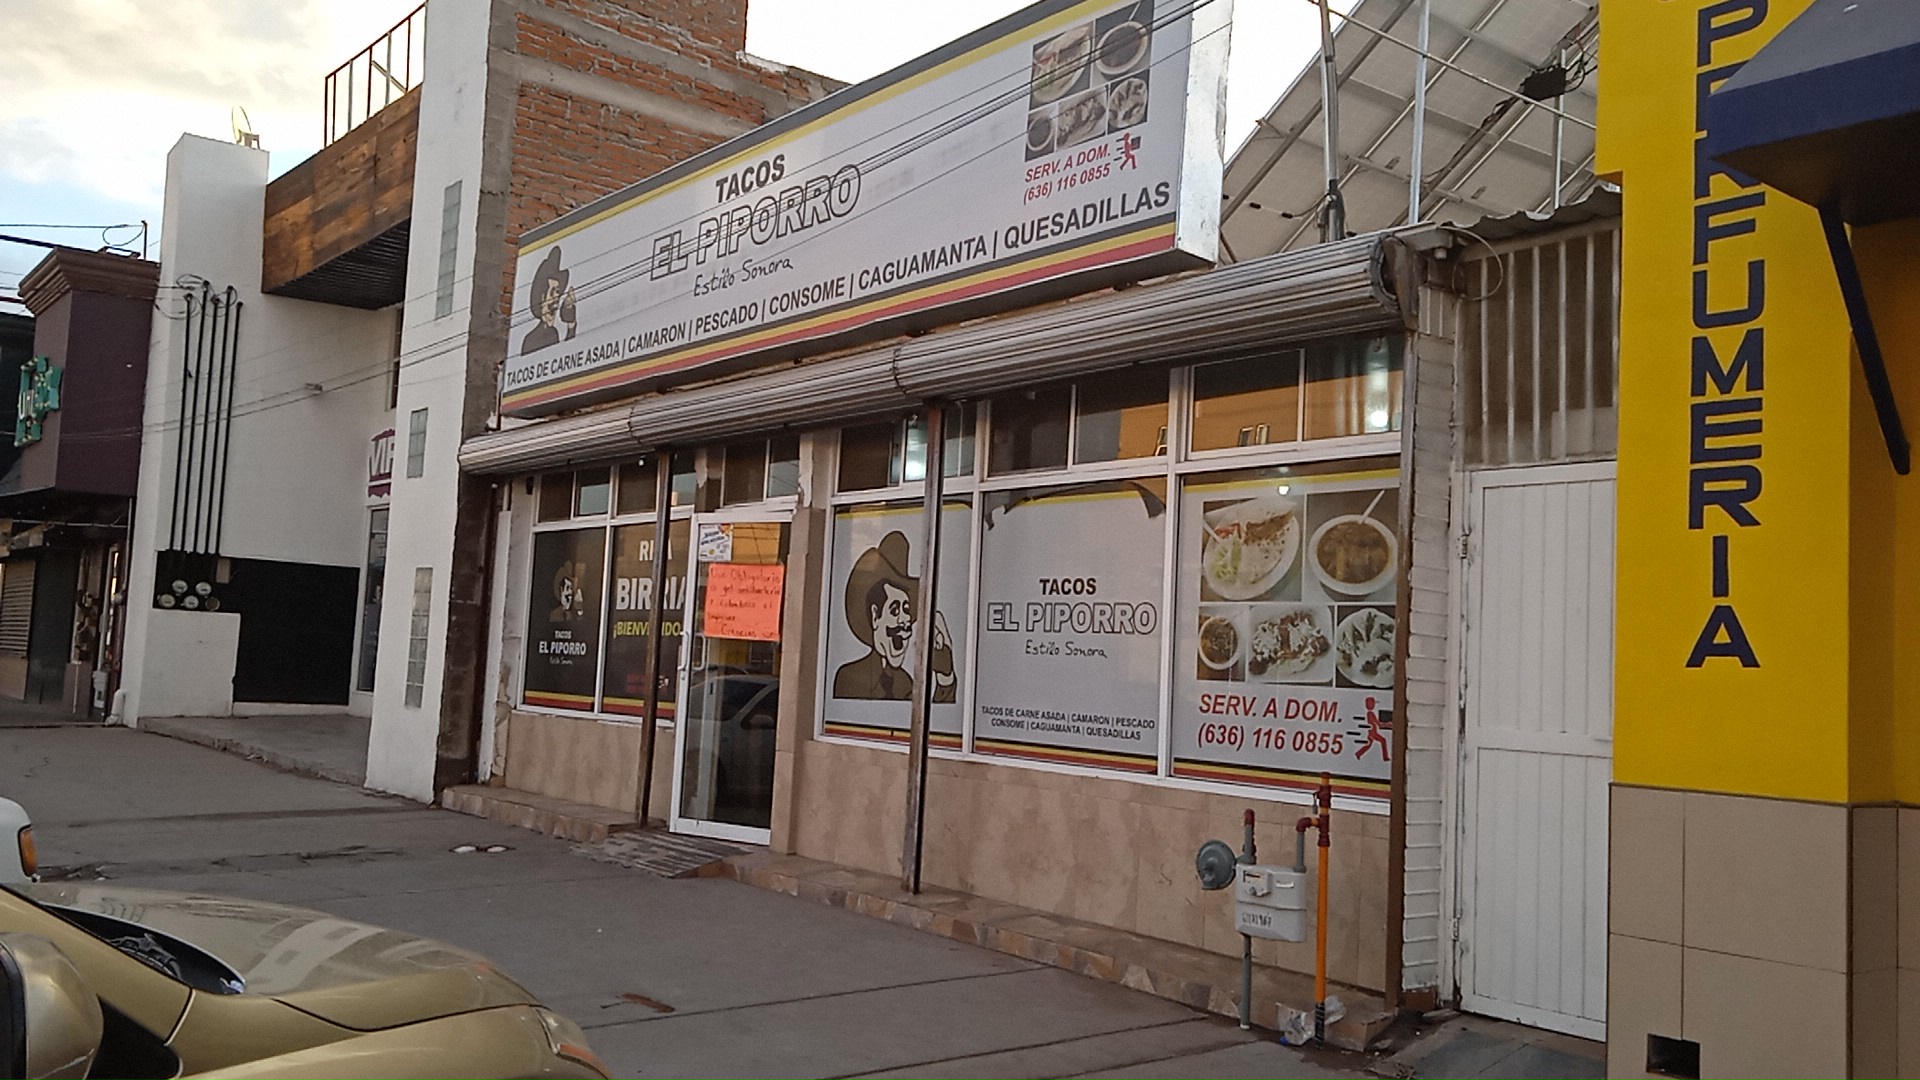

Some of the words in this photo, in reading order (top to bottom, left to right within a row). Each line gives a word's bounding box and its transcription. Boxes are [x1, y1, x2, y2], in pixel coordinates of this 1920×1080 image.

[715, 154, 785, 203] TACOS
[1025, 159, 1060, 183] SERV.
[1063, 155, 1073, 171] A
[1076, 143, 1111, 166] DOM.
[1023, 182, 1053, 205] (636)
[1057, 173, 1076, 192] 116
[1080, 162, 1111, 185] 0855
[650, 230, 689, 281] EL
[696, 164, 861, 266] PIPORRO
[507, 366, 535, 387] TACOS
[536, 361, 549, 379] DE
[550, 351, 583, 375] CARNE
[584, 340, 620, 365] ASADA
[628, 321, 686, 353] CAMARON
[695, 301, 758, 336] PESCADO
[769, 276, 846, 315] CONSOME
[858, 235, 987, 291] CAGUAMANTA
[1004, 181, 1171, 249] QUESADILLAS
[693, 267, 735, 297] Estilo
[741, 257, 794, 282] Sonora
[1039, 577, 1097, 596] TACOS
[986, 602, 1020, 632] EL
[1026, 601, 1157, 635] PIPORRO
[538, 641, 549, 654] EL
[550, 641, 587, 656] PIPORRO
[1025, 639, 1060, 656] Estilo
[1065, 641, 1108, 659] Sonora
[981, 705, 1004, 716] TACOS
[1005, 707, 1014, 717] DE
[1016, 709, 1040, 719] CARNE
[1041, 711, 1066, 721] ASADA
[1071, 713, 1110, 725] CAMARON
[1116, 717, 1155, 729] PESCADO
[1199, 693, 1257, 717] SERV.
[1263, 698, 1278, 719] A
[1284, 699, 1342, 723] DOM.
[991, 718, 1025, 729] CONSOME
[1030, 721, 1081, 735] CAGUAMANTA
[1086, 726, 1141, 740] QUESADILLAS
[1198, 723, 1245, 751] (636)
[1252, 727, 1285, 750] 116
[1292, 731, 1344, 755] 0855
